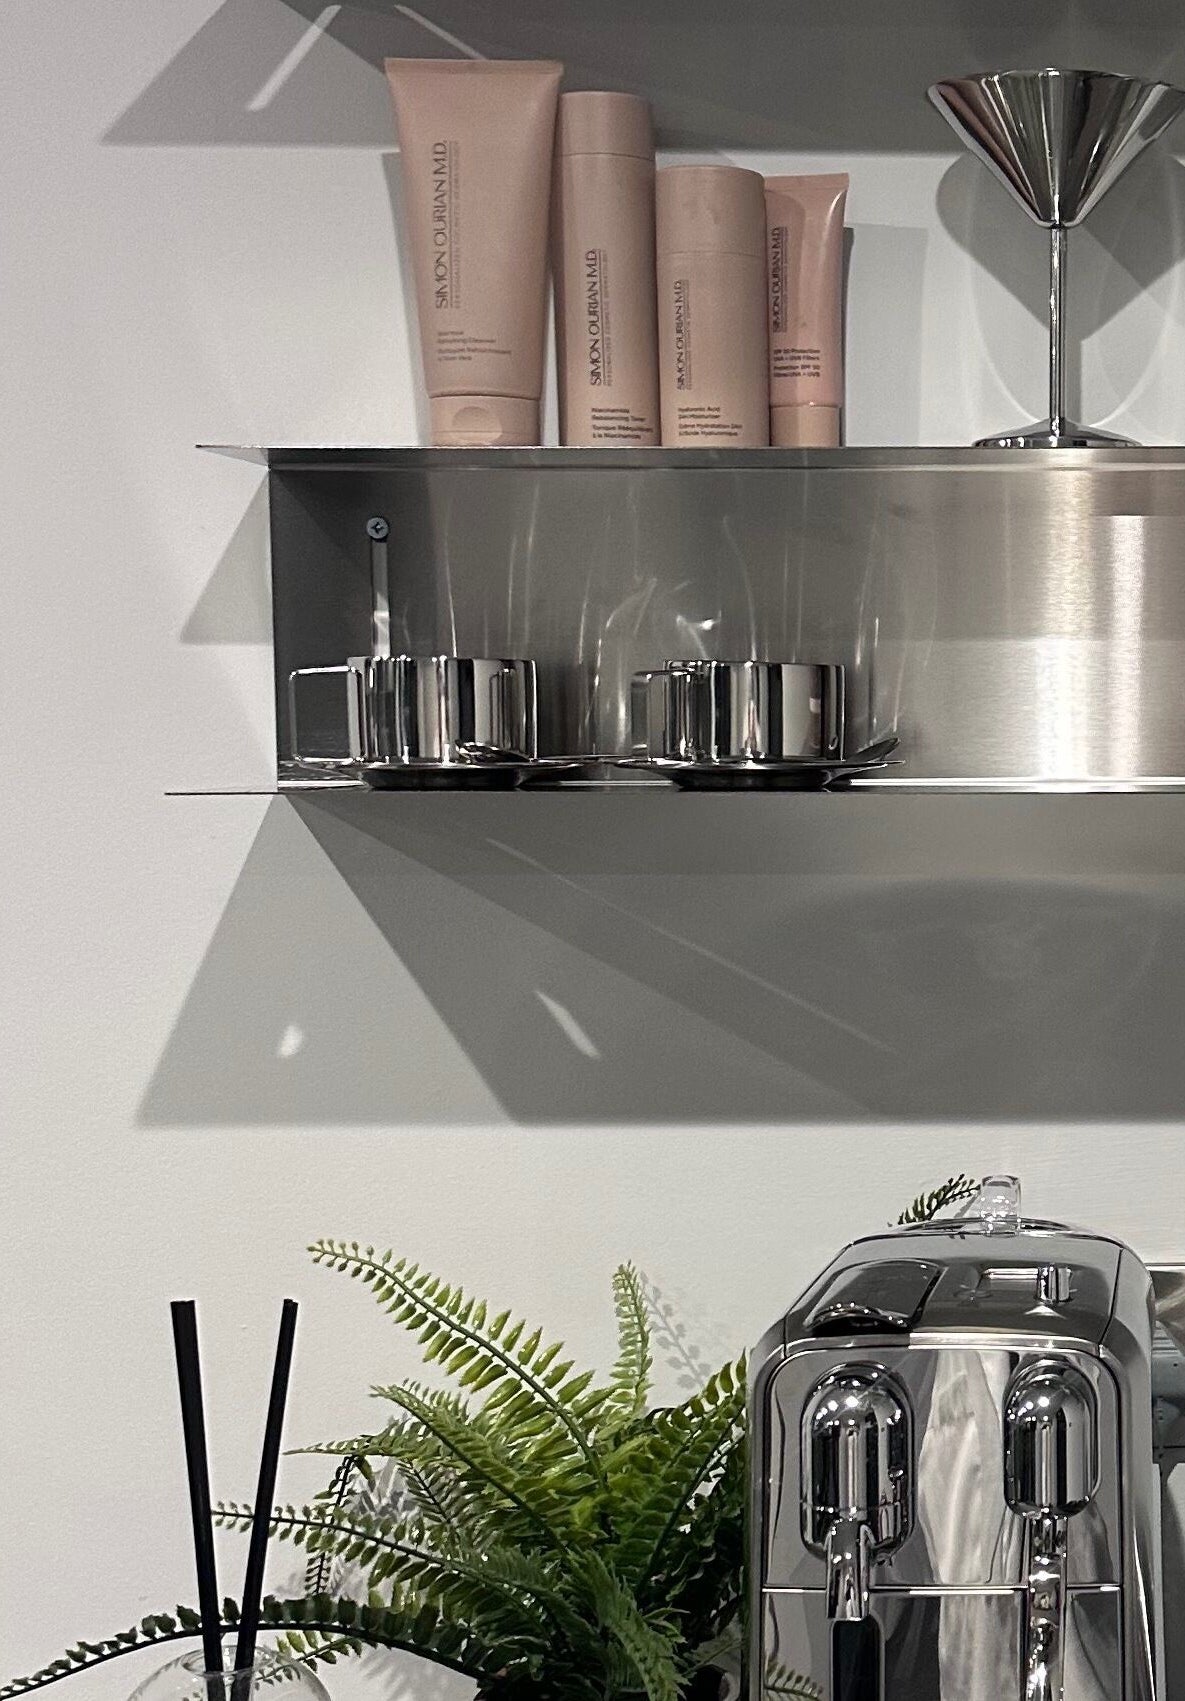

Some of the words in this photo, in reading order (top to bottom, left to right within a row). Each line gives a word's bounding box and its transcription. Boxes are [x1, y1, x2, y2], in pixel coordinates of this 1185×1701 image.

[433, 179, 447, 247] OURIAN
[434, 251, 448, 309] SIMON
[587, 281, 600, 335] OURIAN
[675, 305, 684, 350] OURIAN
[773, 296, 781, 333] SIMON
[590, 339, 601, 386] SIMON
[677, 351, 685, 390] SIMON
